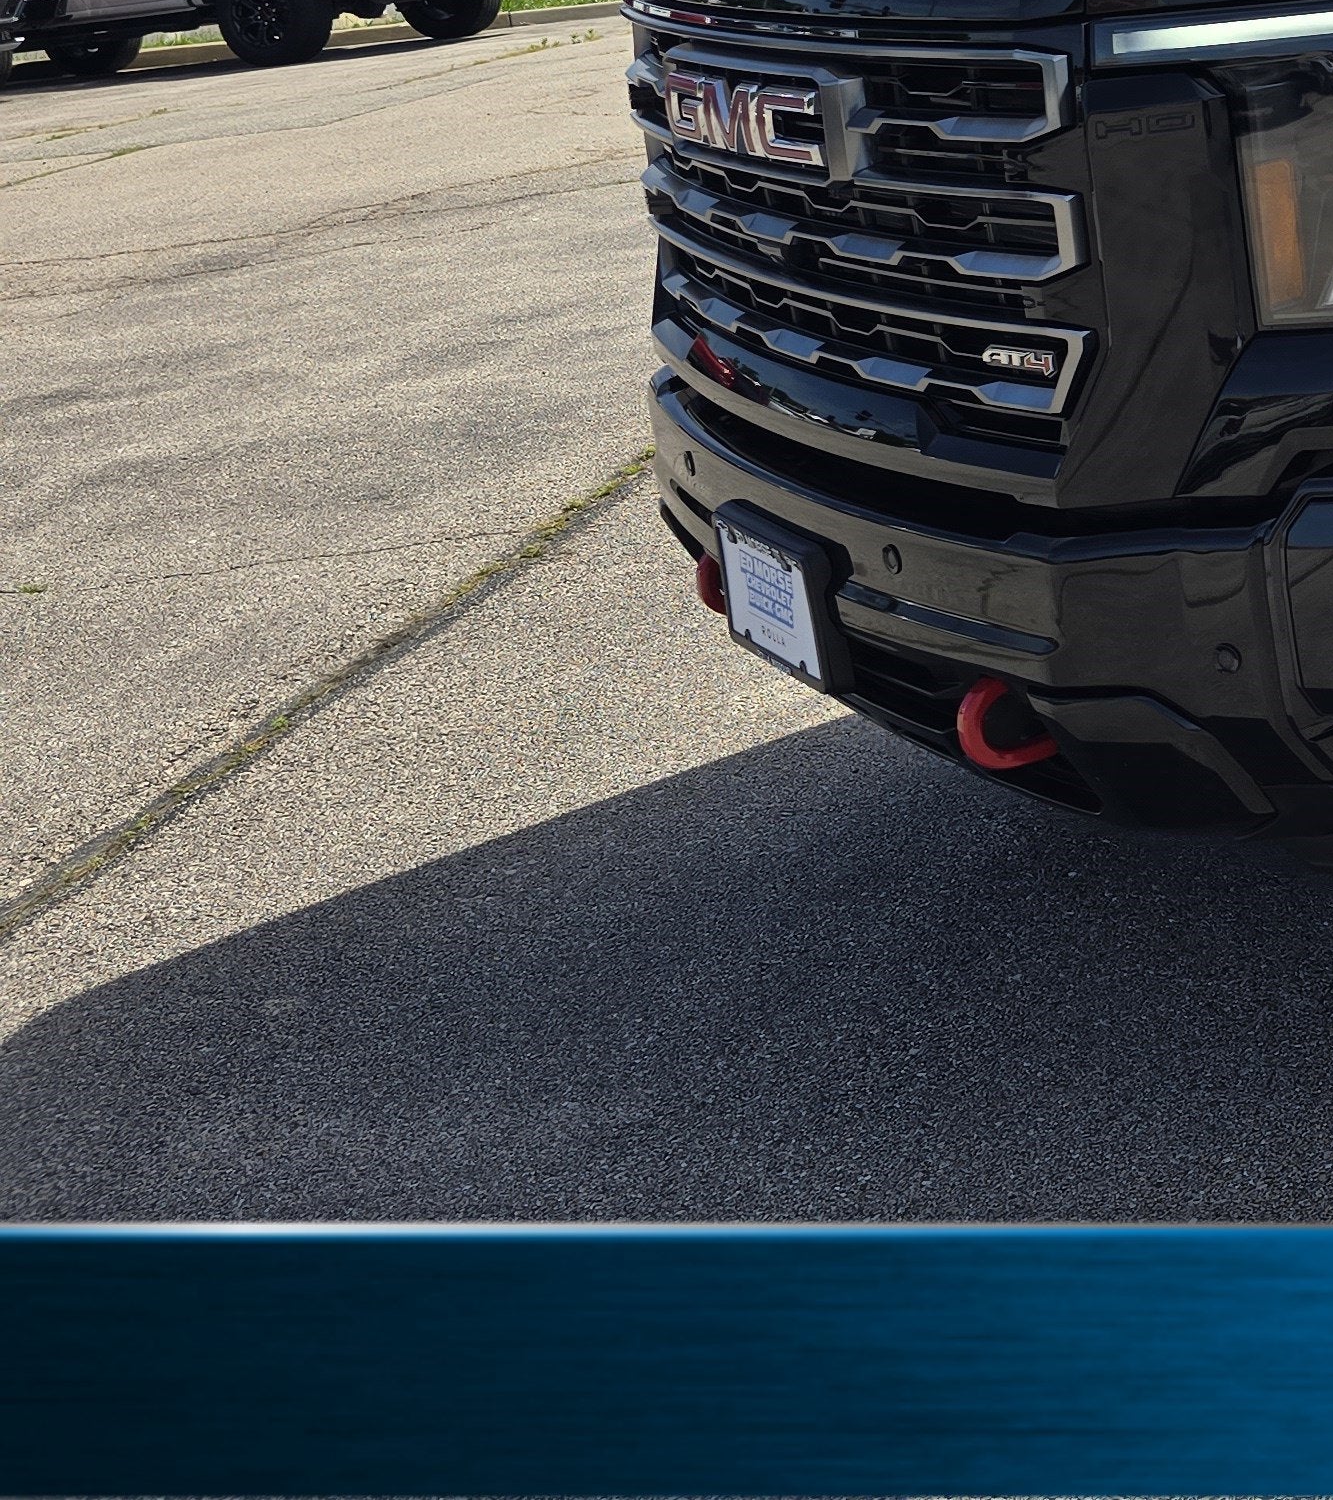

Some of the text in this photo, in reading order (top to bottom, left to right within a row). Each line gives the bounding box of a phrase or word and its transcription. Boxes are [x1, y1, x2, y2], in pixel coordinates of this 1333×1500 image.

[664, 69, 828, 167] GMC
[982, 347, 1055, 377] AT4
[753, 556, 793, 592] MORSE
[761, 624, 786, 647] ROLLA
